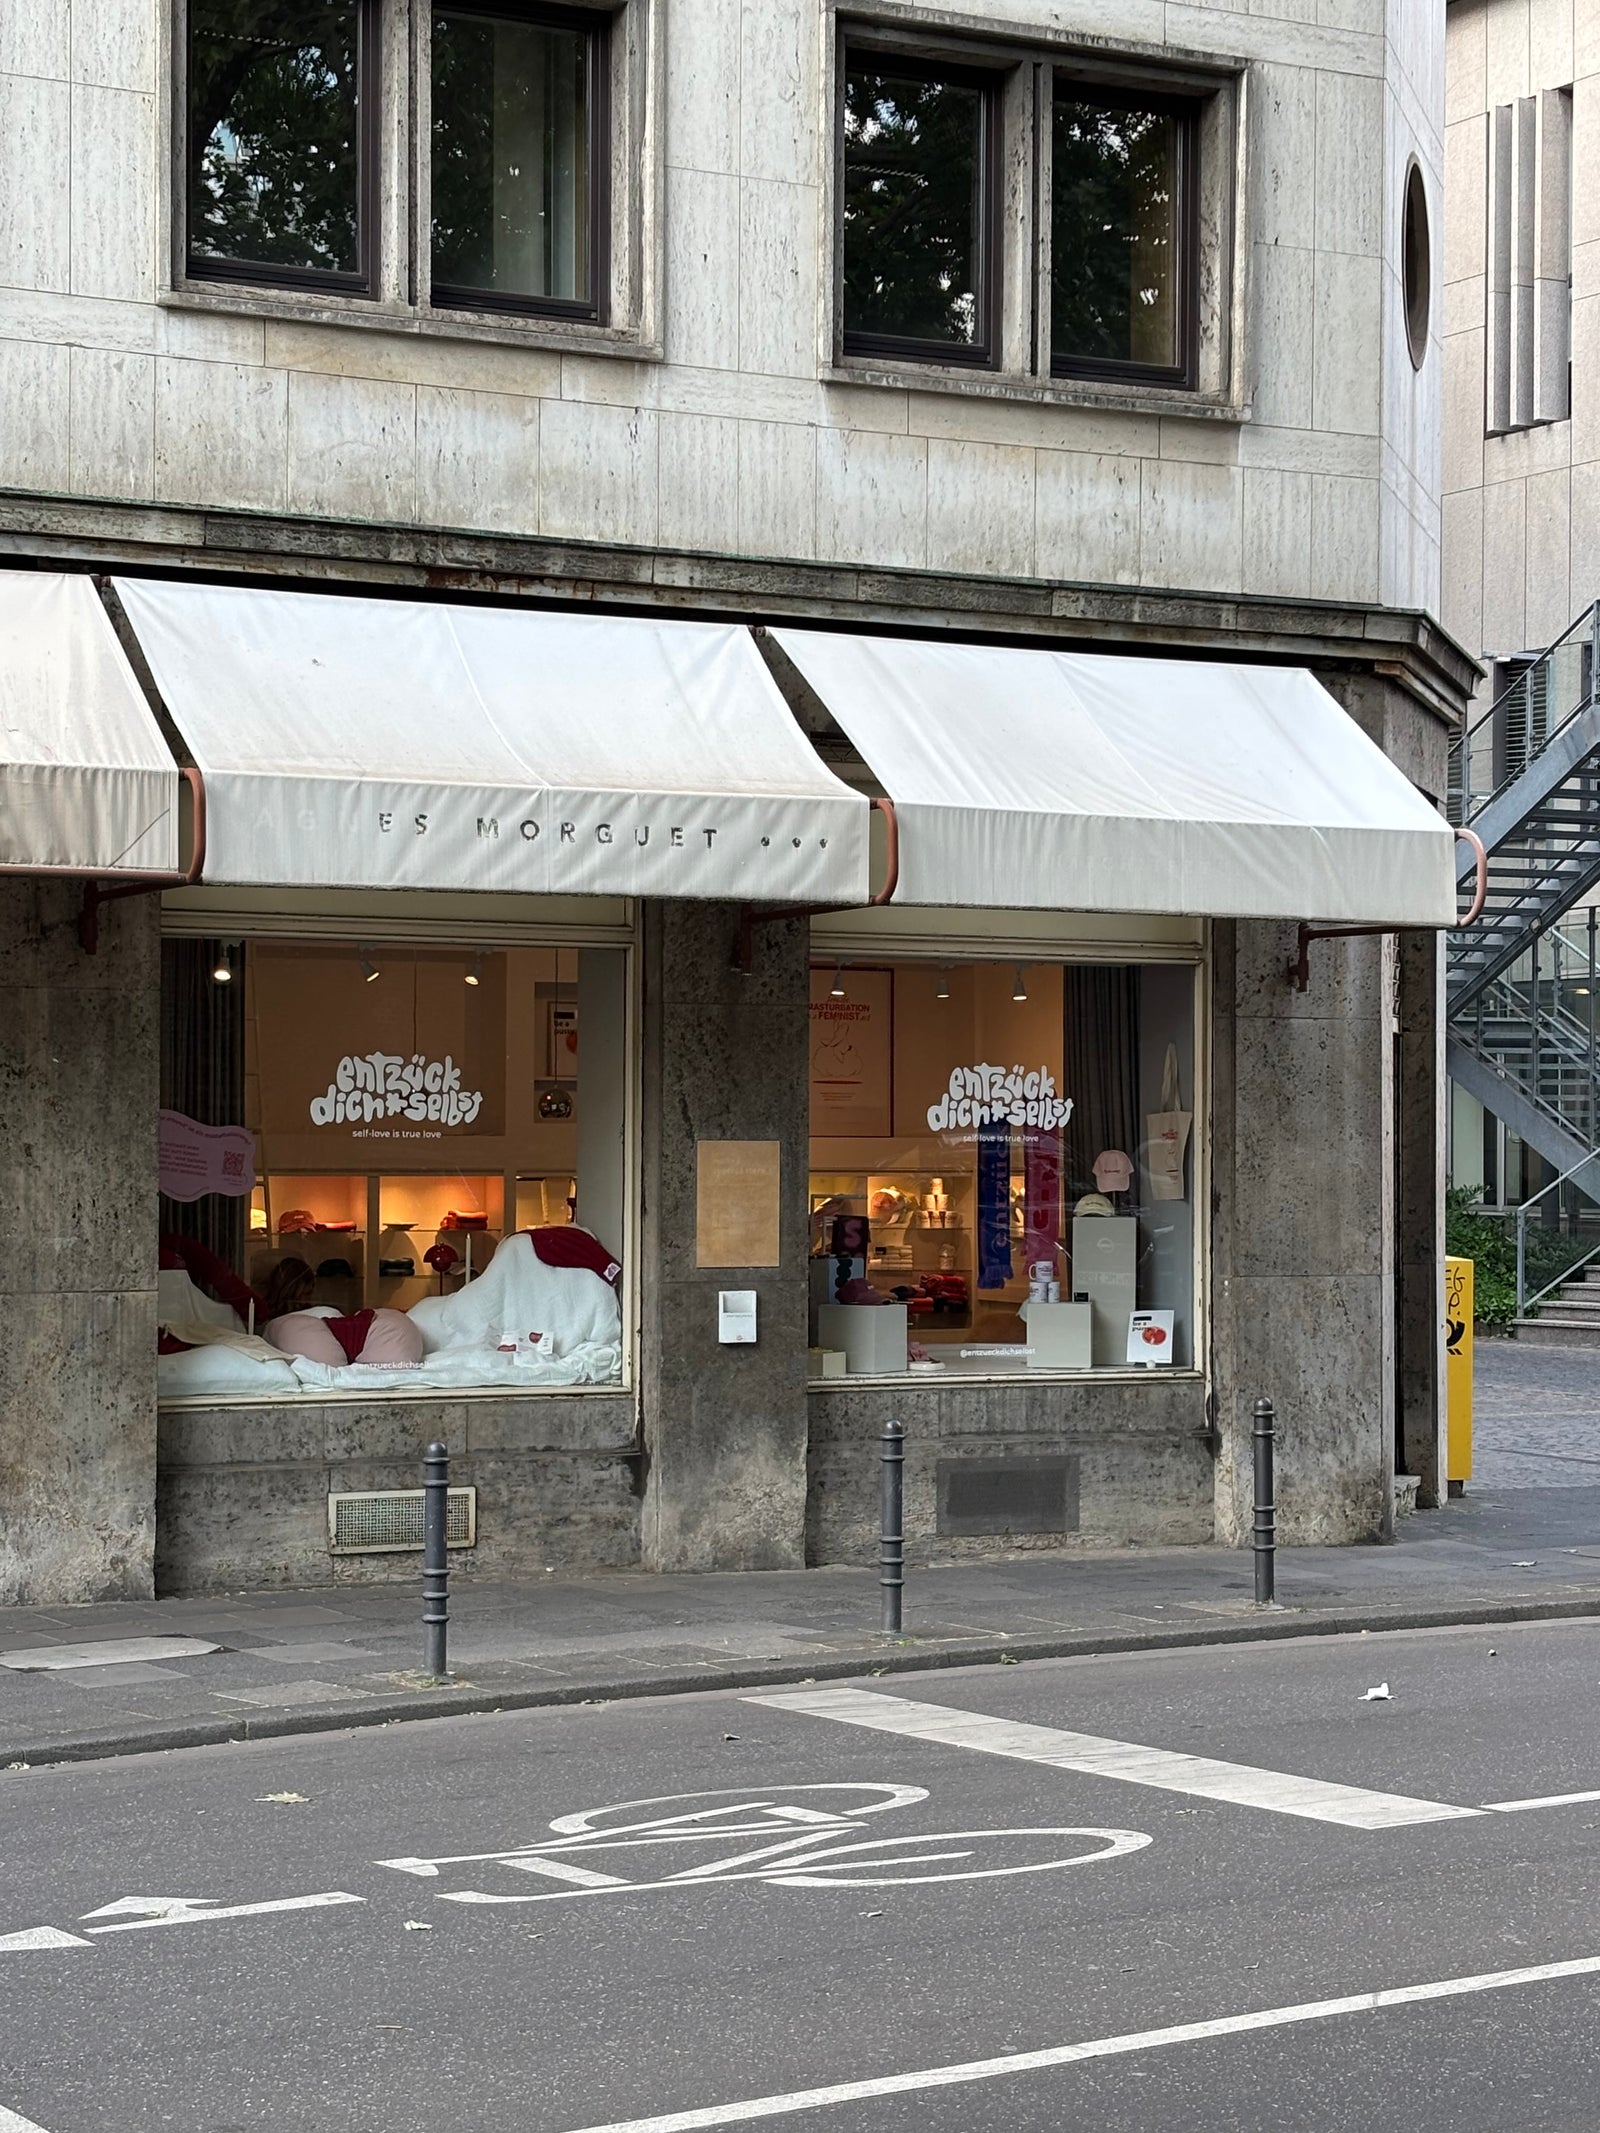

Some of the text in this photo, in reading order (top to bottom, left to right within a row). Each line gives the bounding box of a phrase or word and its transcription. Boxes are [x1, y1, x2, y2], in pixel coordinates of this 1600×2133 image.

[476, 816, 718, 849] MORGUET
[819, 1011, 860, 1021] FEMINIST
[336, 1051, 461, 1097] entzück
[949, 1062, 1055, 1104] entzück
[352, 1128, 442, 1139] self-love is true love
[963, 1134, 995, 1143] self-love
[1005, 1135, 1021, 1143] true
